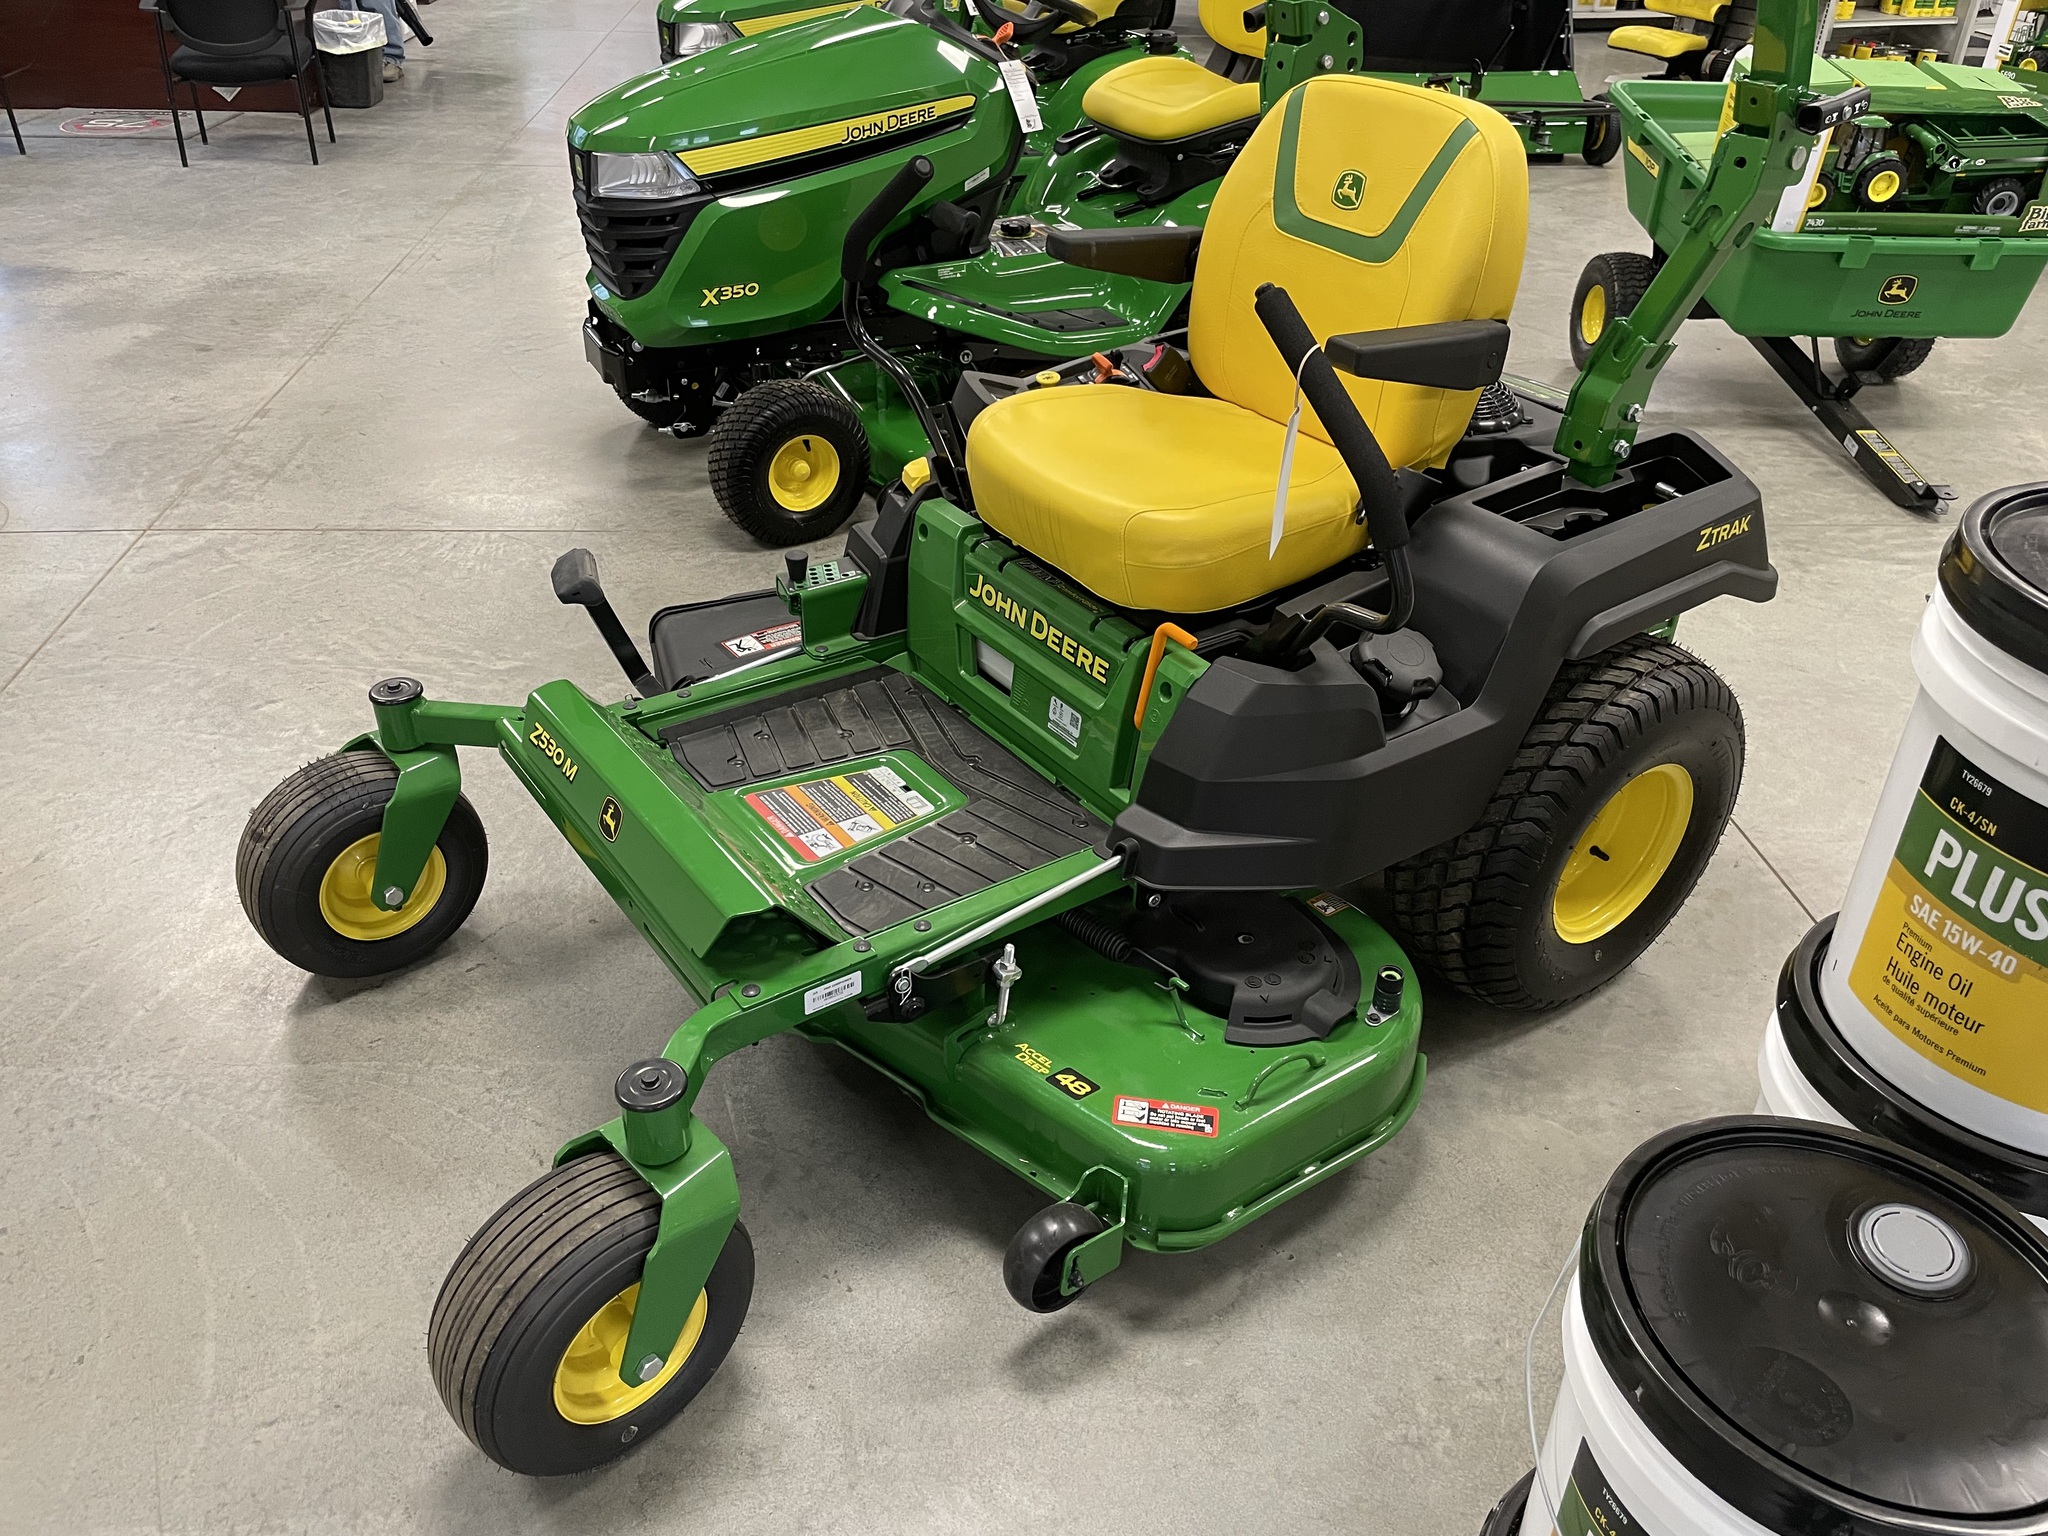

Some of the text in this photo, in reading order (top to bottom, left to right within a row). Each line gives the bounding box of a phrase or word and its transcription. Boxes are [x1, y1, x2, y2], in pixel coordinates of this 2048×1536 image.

[841, 106, 936, 143] JOHN DEERE
[1806, 219, 1825, 227] 7430
[700, 282, 760, 308] X350
[1851, 309, 1922, 319] JOHN DEERE
[1696, 514, 1752, 552] ZTRAK
[969, 573, 1028, 630] JOHN
[1029, 609, 1110, 685] DEERE
[529, 721, 579, 782] Z530 M
[1961, 769, 1993, 797] TY26679
[1950, 796, 1998, 837] CK-4/SN
[1924, 828, 2048, 941] PLUS
[1903, 921, 1933, 952] Premium
[1910, 894, 2018, 975] SAE 15W-40
[1896, 932, 1973, 998] Engine Oil
[1882, 975, 1959, 1036] de qualité supérieure
[1886, 956, 1985, 1034] Huile moteur
[1873, 994, 1987, 1077] Aceite para Motores Premium
[1014, 1052, 1050, 1075] DEEP
[1015, 1043, 1052, 1068] ACCEL
[1055, 1073, 1092, 1096] 48
[1170, 1103, 1201, 1112] DANGER
